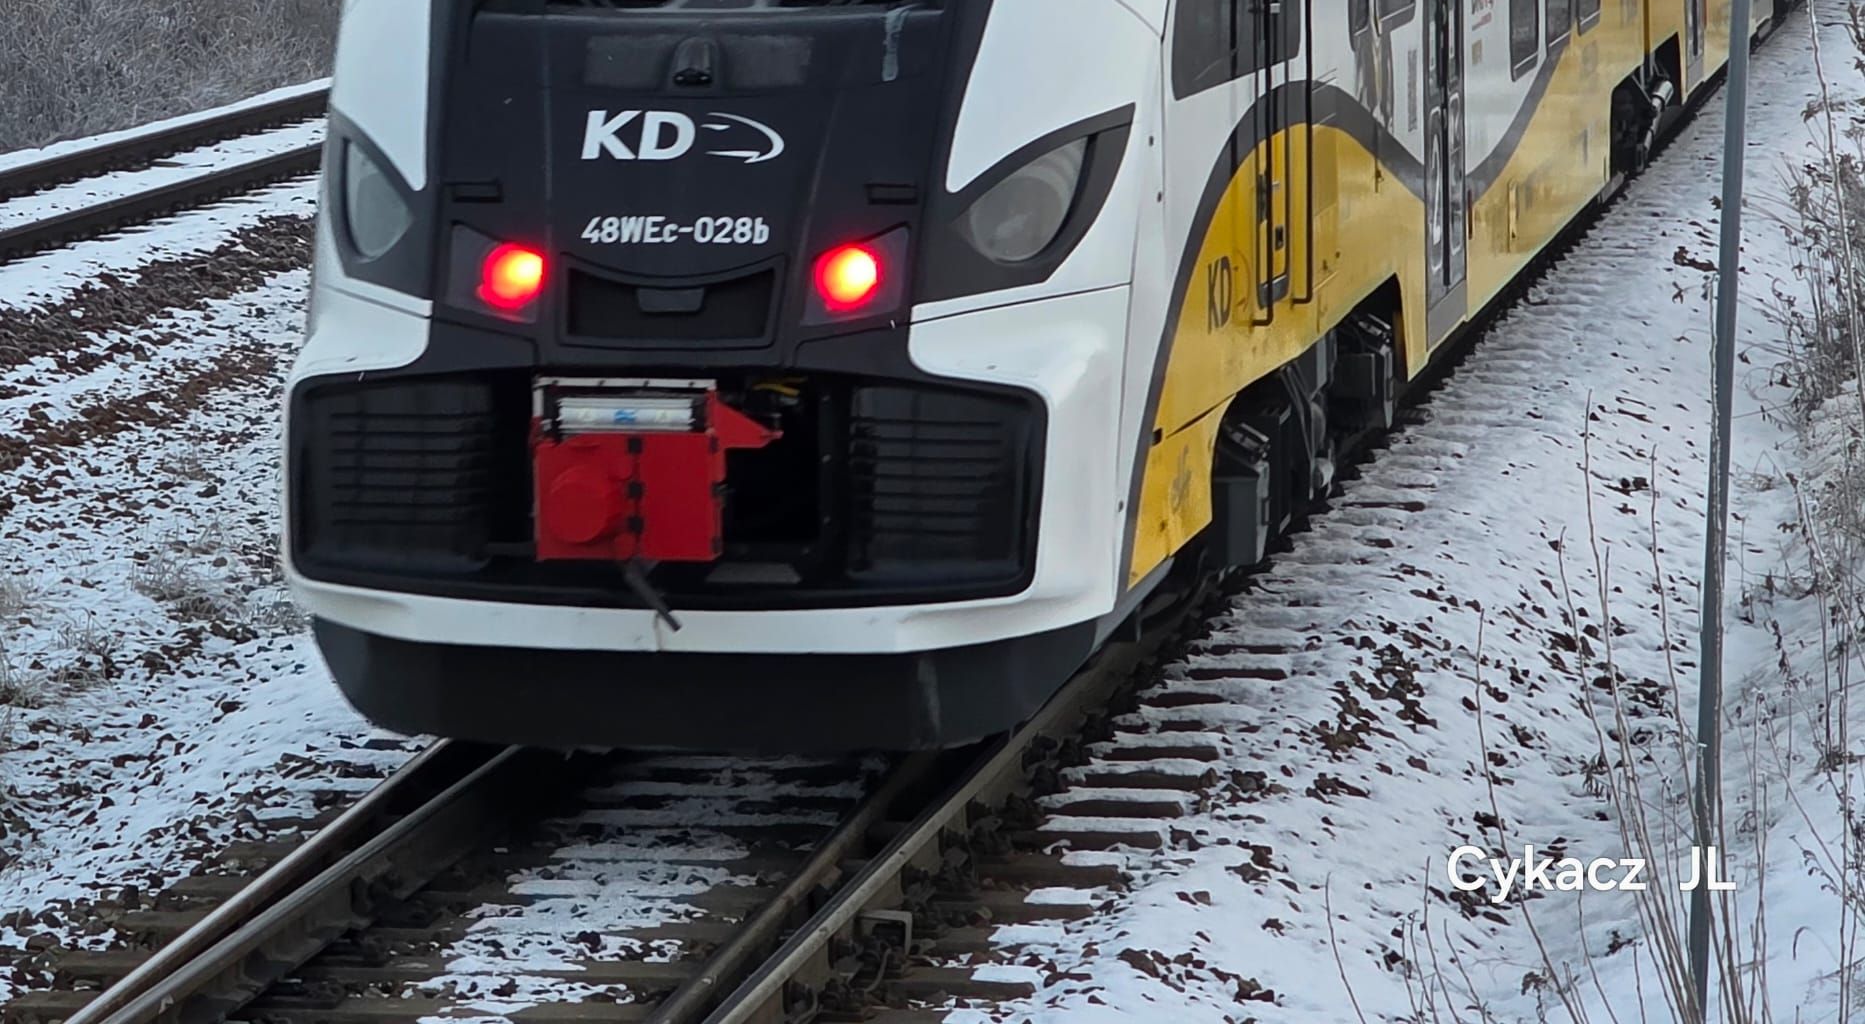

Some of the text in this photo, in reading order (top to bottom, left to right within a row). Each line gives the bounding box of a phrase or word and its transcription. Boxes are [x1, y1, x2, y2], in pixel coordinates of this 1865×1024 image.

[581, 110, 697, 161] KD
[581, 215, 770, 245] 48WEc-028b
[1207, 255, 1233, 335] KD
